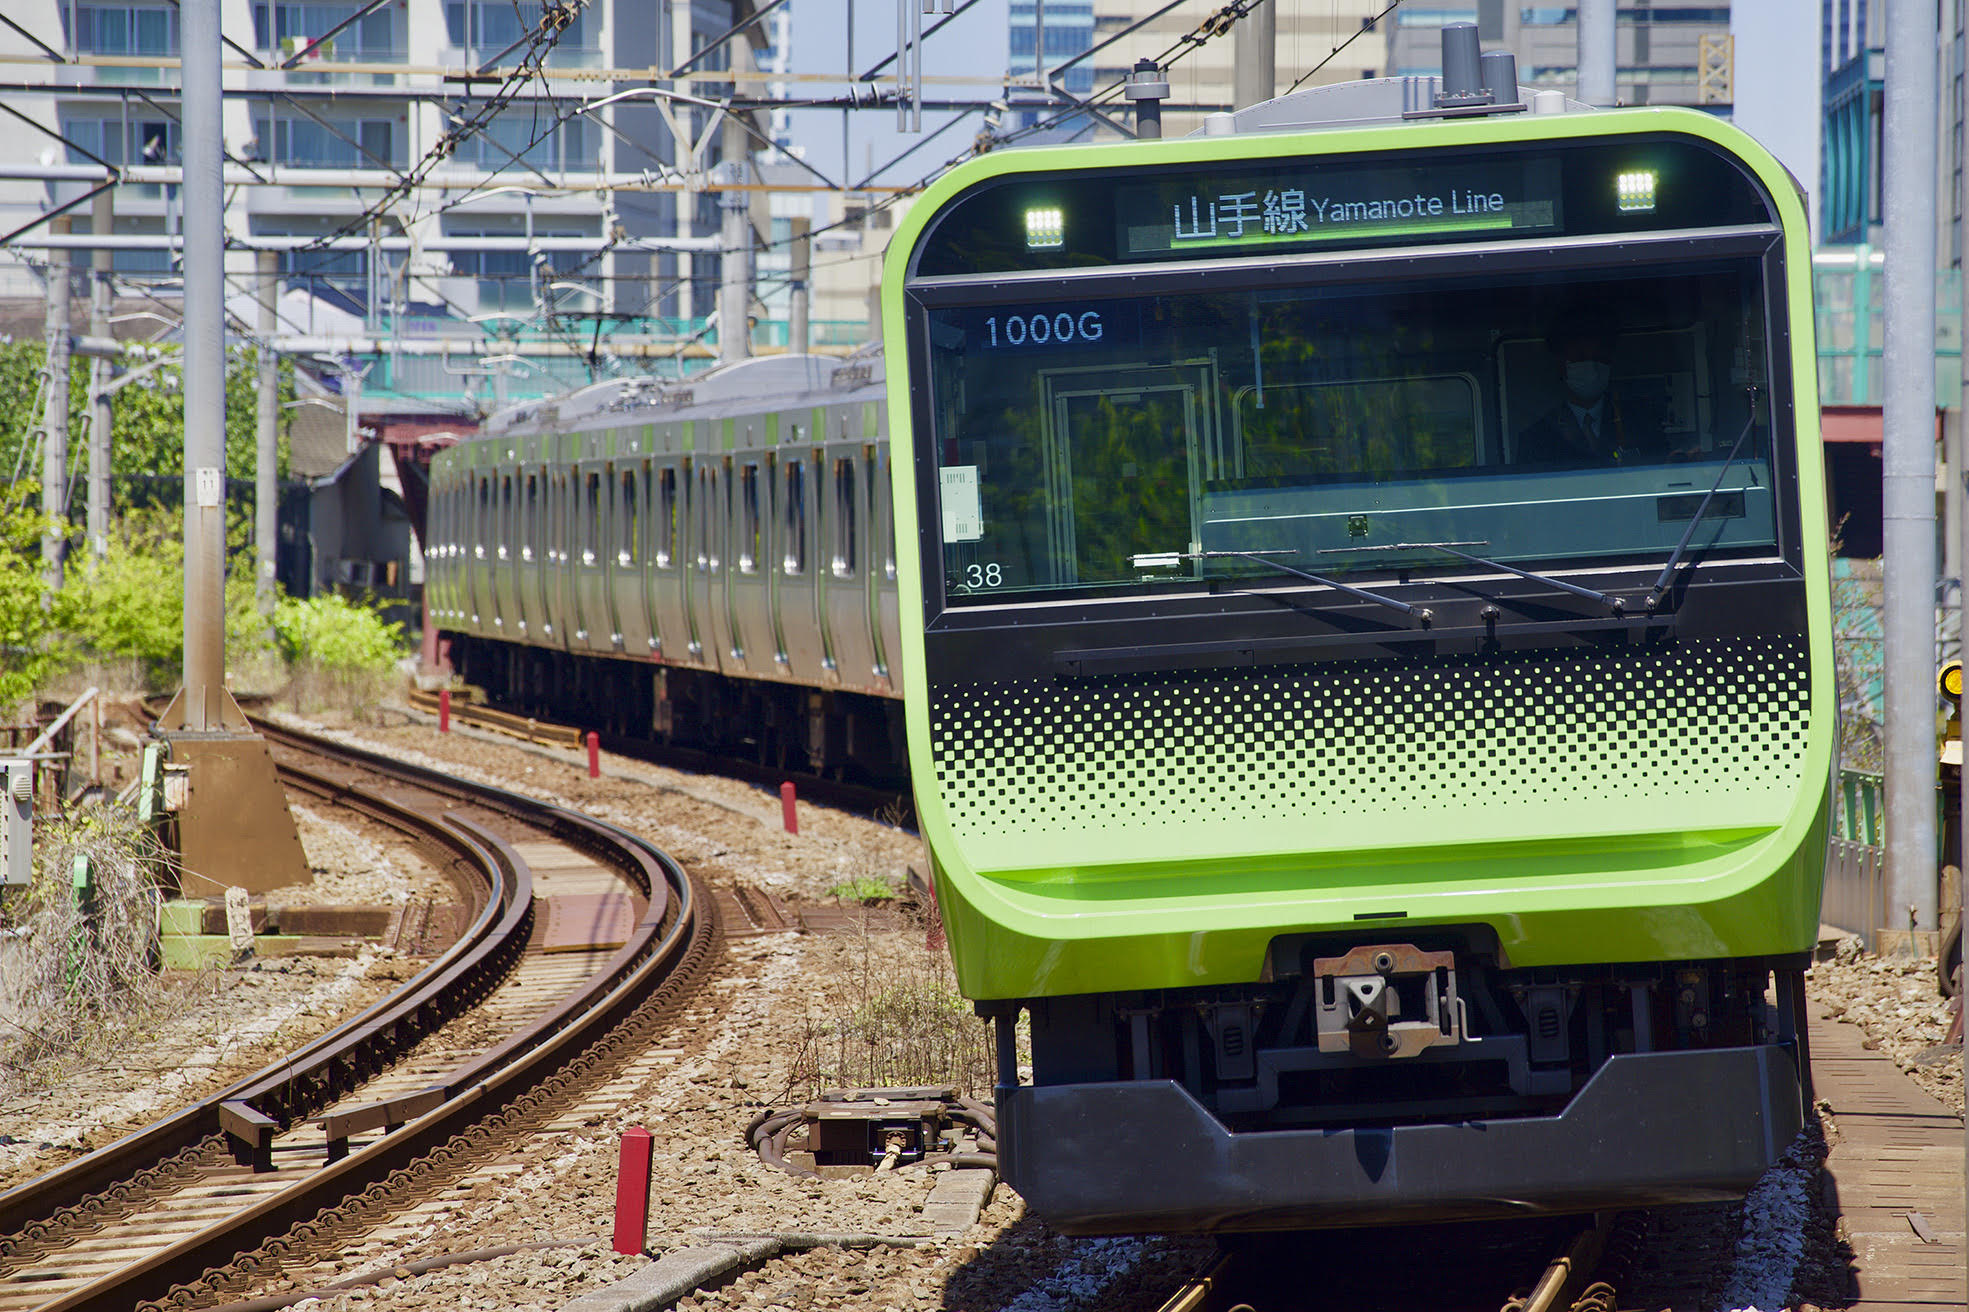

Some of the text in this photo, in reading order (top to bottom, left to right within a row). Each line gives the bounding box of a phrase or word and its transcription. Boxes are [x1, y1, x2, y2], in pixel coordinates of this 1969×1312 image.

[1174, 188, 1504, 239] 山手線 Yamanote Line
[985, 311, 1103, 347] 1000G
[966, 563, 1002, 588] 38
